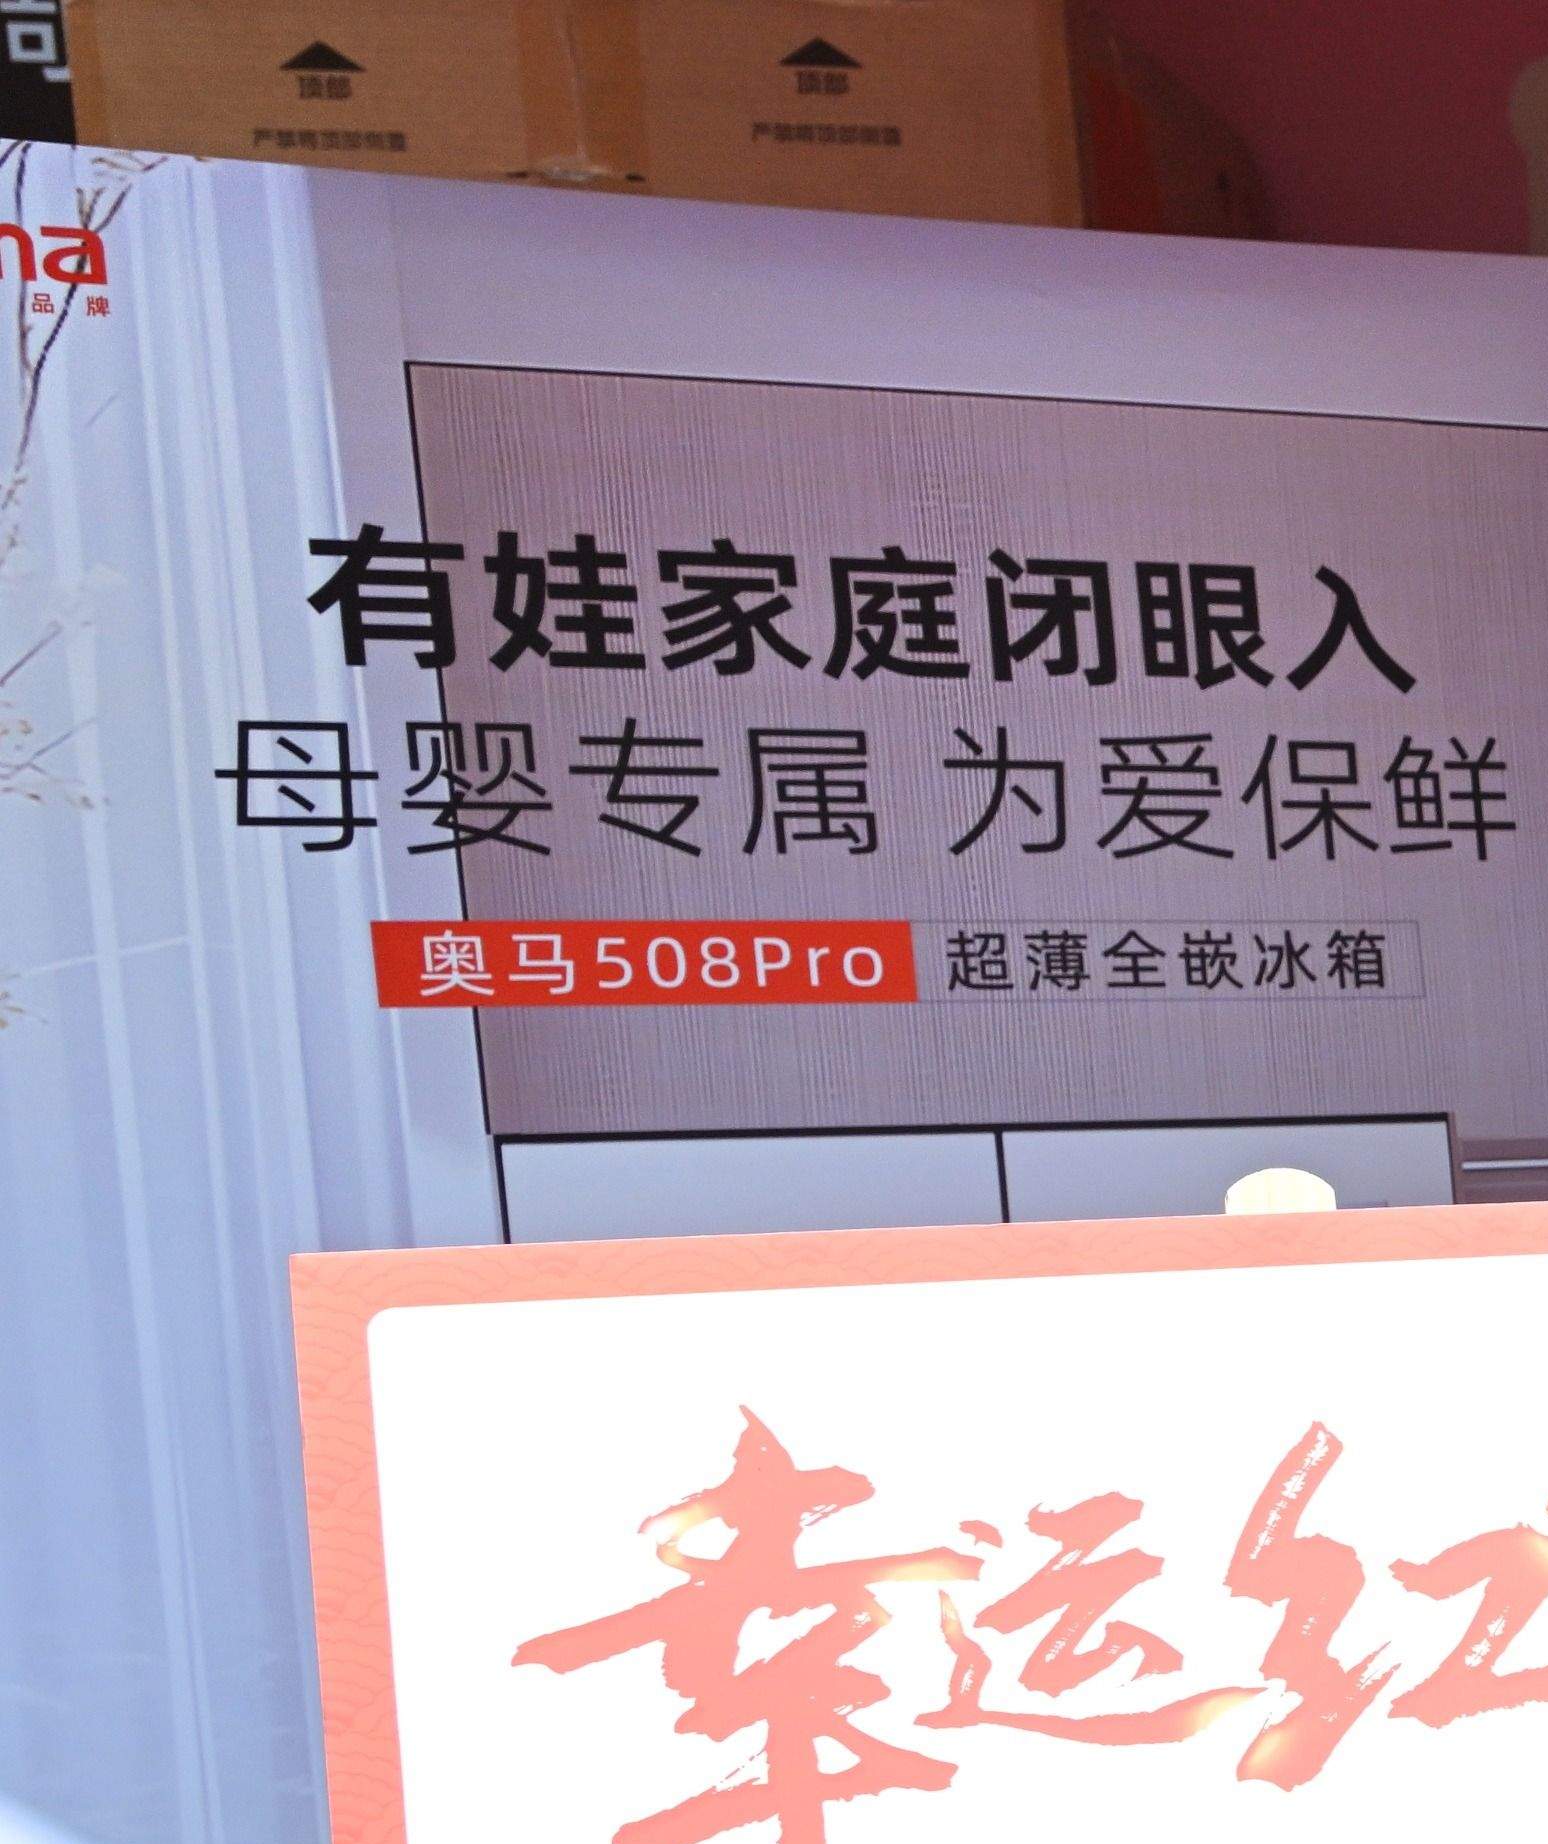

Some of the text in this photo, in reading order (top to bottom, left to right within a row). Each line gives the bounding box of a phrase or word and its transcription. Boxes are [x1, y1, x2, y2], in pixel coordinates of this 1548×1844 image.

[305, 522, 1418, 694] 有娃家庭闭眼入
[213, 716, 1518, 863] 母婴专属 为爱保鲜
[418, 929, 1389, 997] 奥马508Pro 超薄全嵌冰箱
